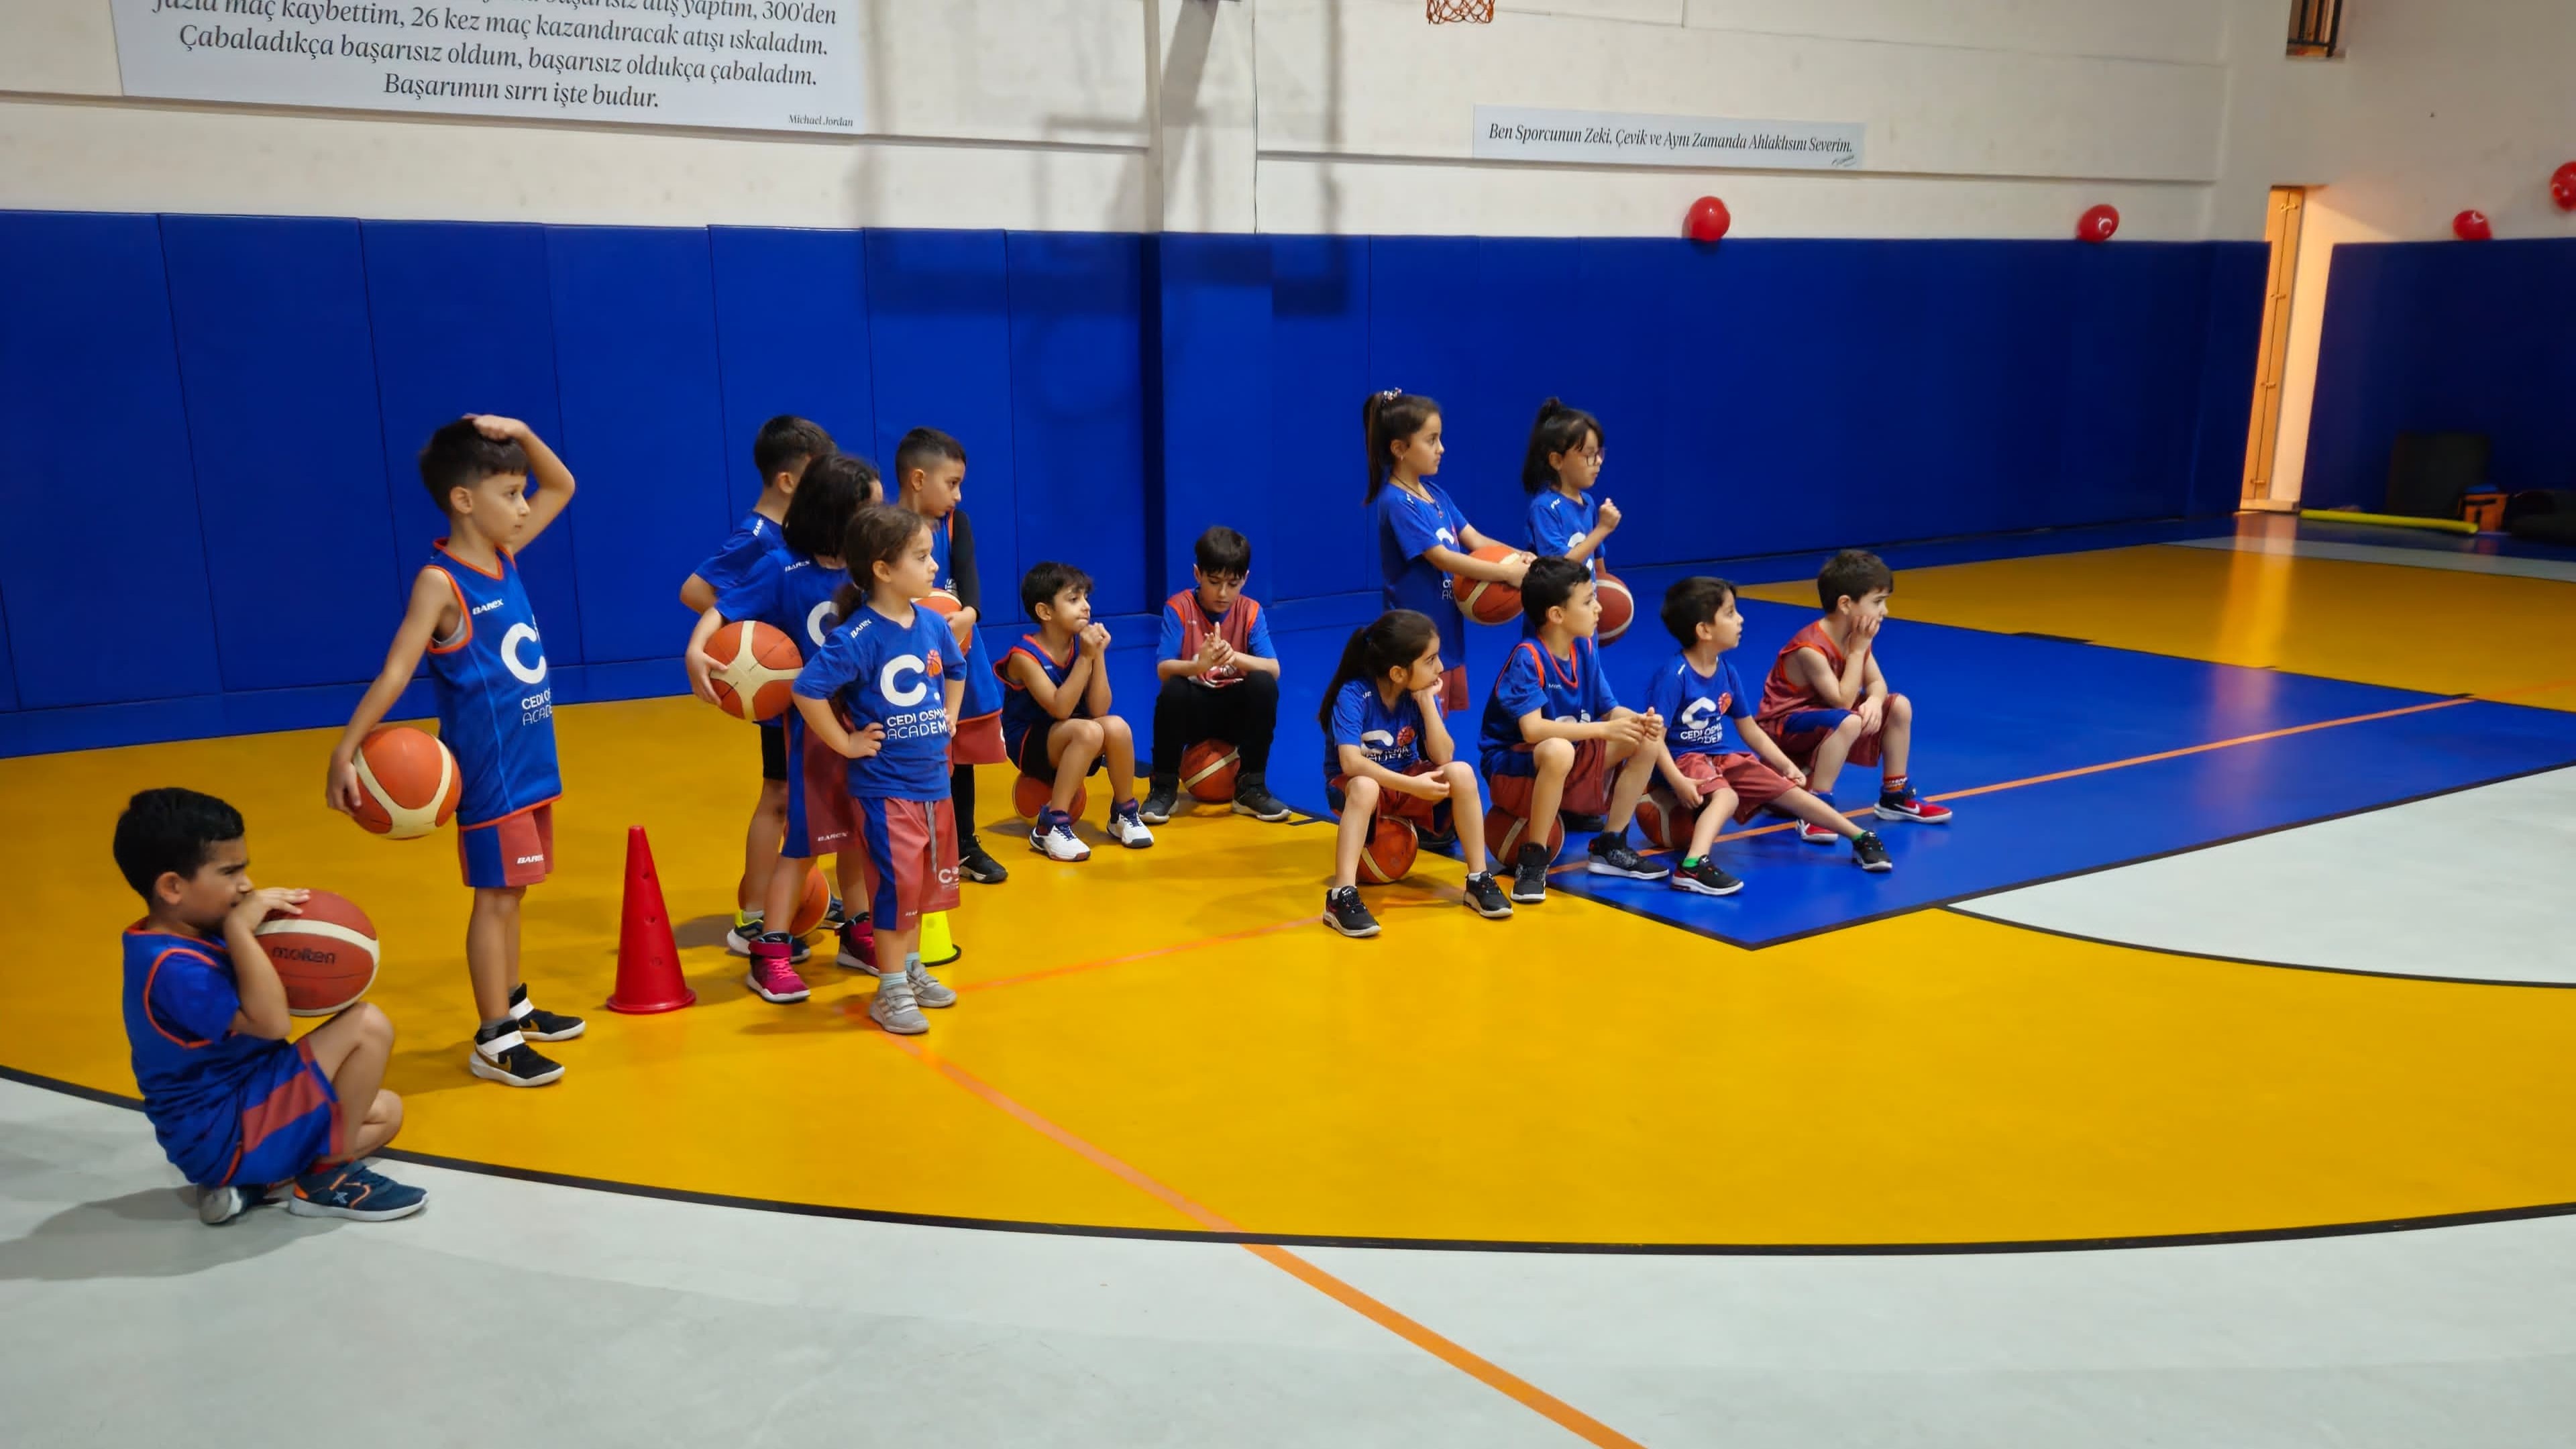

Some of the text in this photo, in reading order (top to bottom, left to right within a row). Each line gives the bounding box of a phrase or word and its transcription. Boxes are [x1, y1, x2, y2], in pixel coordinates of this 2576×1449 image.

[682, 0, 757, 19] yaptım,
[763, 1, 837, 24] 300'den
[225, 0, 276, 21] maç
[282, 0, 405, 28] kaybettim,
[411, 7, 438, 28] 26
[445, 7, 480, 30] kez
[486, 16, 531, 40] maç
[536, 15, 678, 45] kazandıracak
[683, 30, 724, 52] atışı
[730, 30, 828, 55] ıskaladım.
[179, 25, 816, 86] Çabaladıkça başarısız oldum, başarısız oldukça çabaladım.
[384, 72, 658, 107] Başarımın sırrı işte budur.
[788, 113, 853, 127] Michael Jordan
[1489, 123, 1513, 139] Ben
[1515, 124, 1582, 144] Sporcunun
[1615, 129, 1648, 148] Çevik
[1650, 133, 1662, 146] ve
[1663, 131, 1690, 150] Aynı
[1692, 133, 1746, 150] Zamanda
[1748, 133, 1807, 151] Ahlaklısını
[1809, 137, 1852, 153] Severim.
[521, 692, 545, 710] CEDI
[886, 712, 917, 727] CEDI
[887, 720, 948, 740] ACADEM
